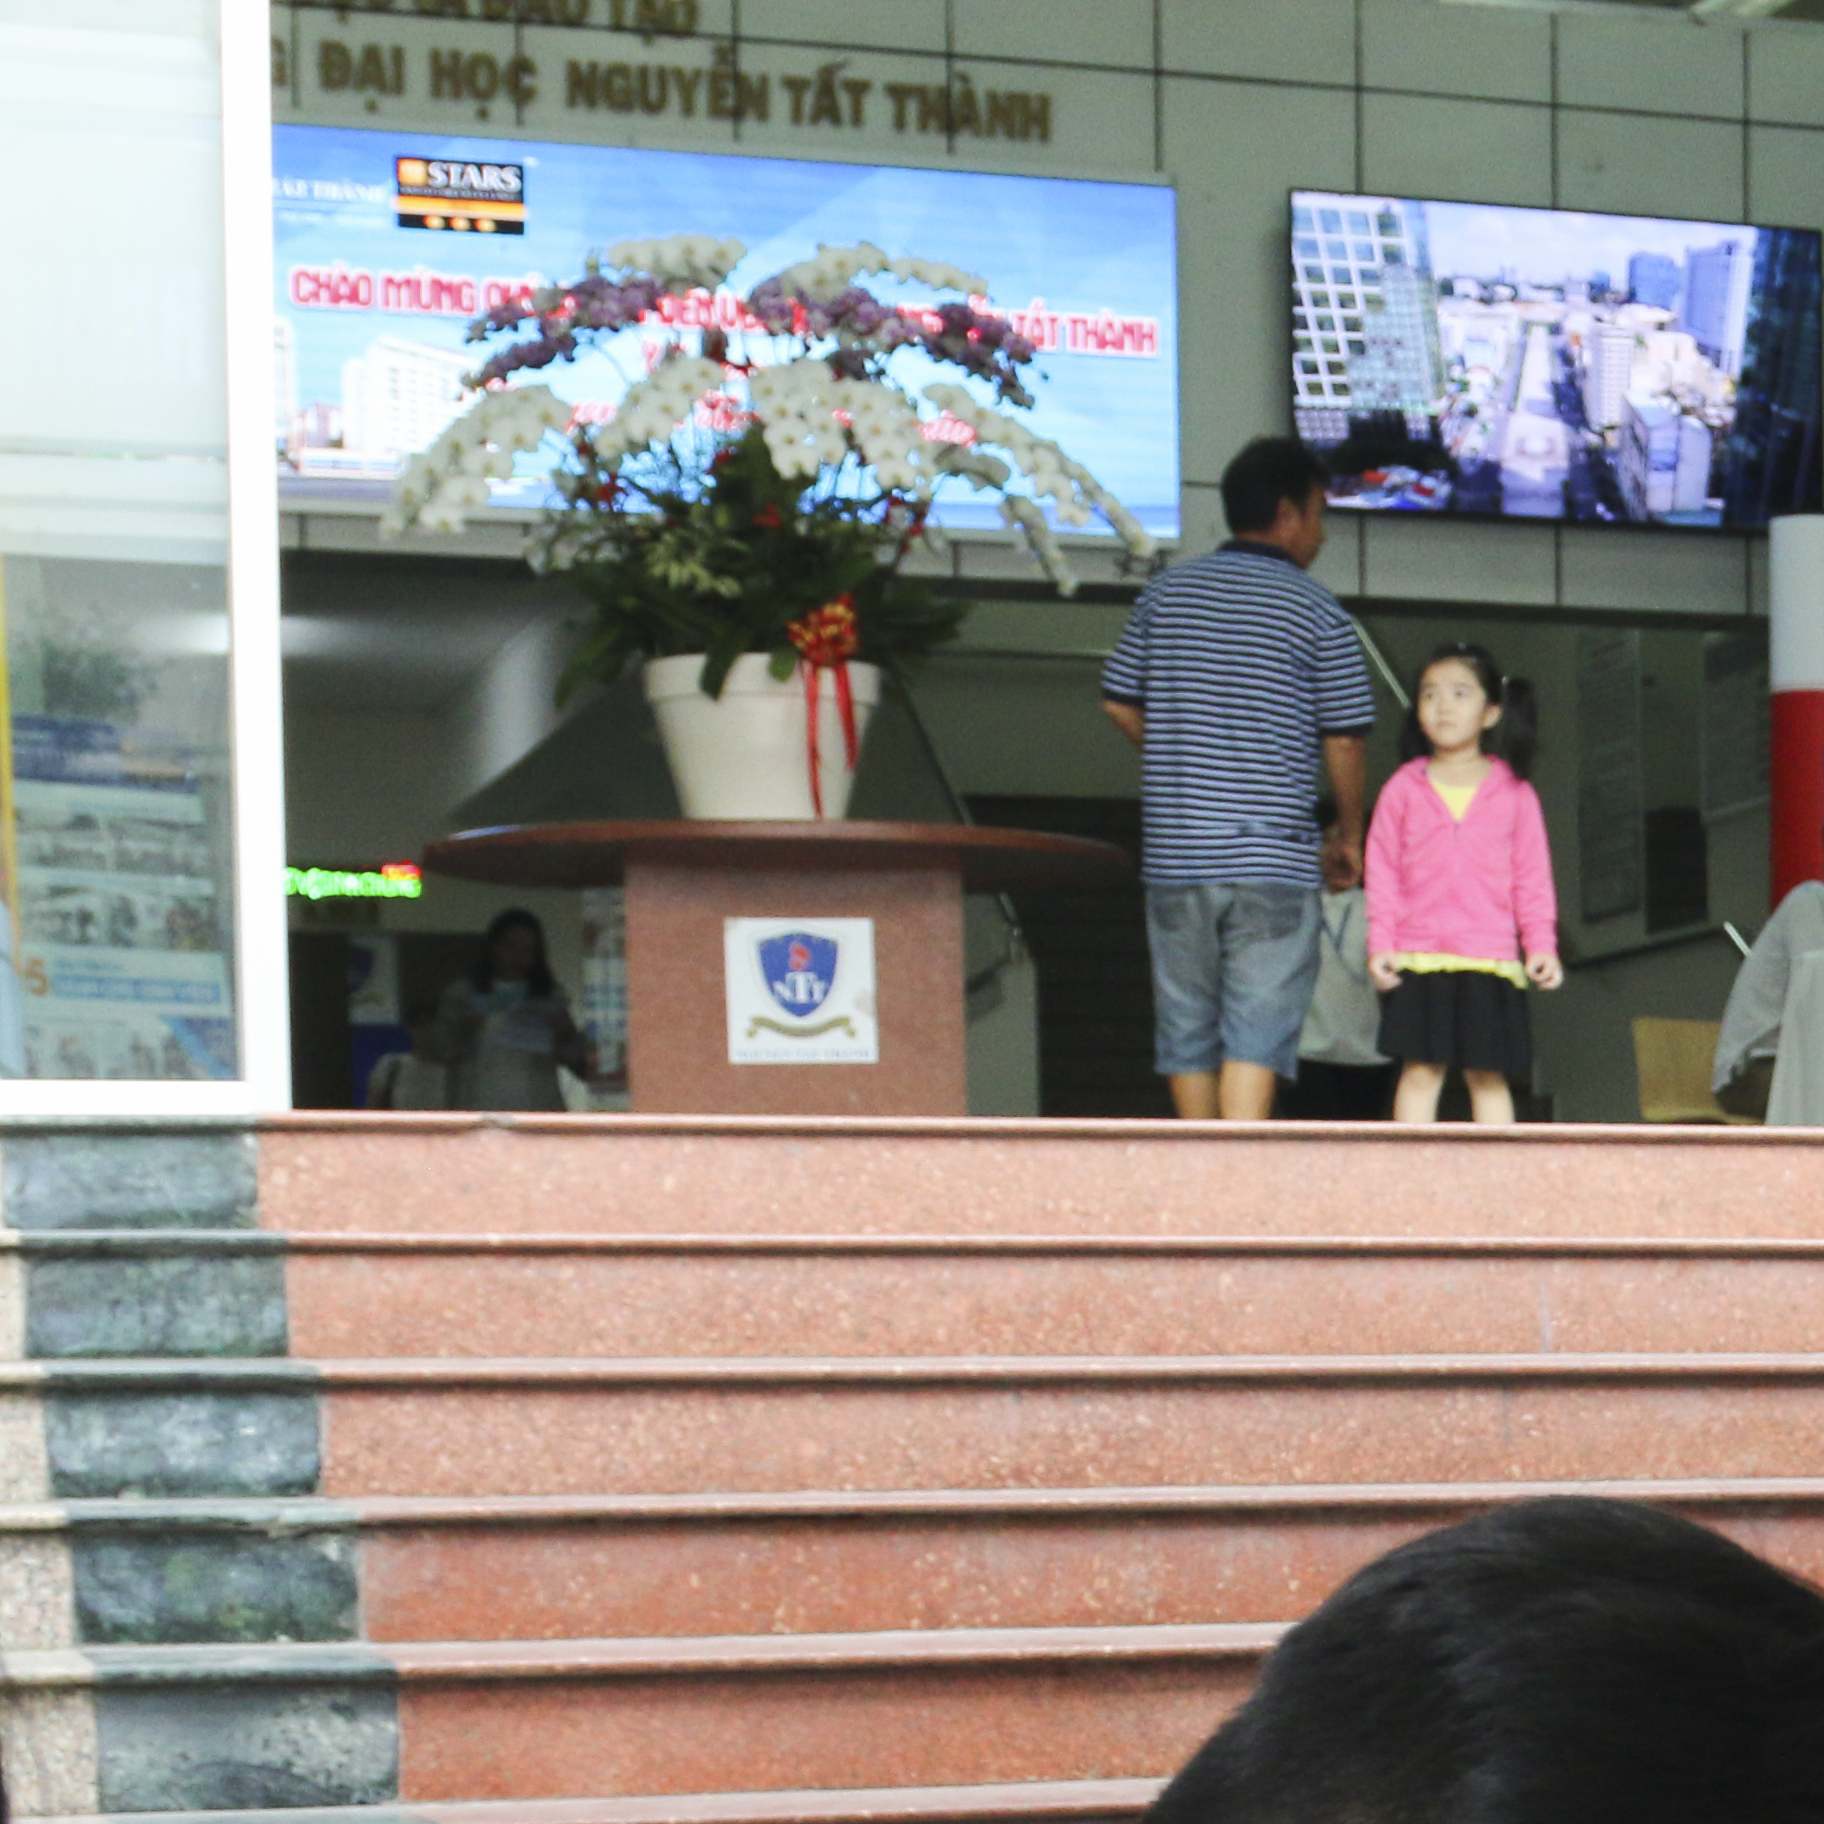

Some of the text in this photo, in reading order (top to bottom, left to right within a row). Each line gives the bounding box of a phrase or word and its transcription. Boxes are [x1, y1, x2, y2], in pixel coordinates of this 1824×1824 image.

[317, 39, 406, 116] ĐẠI
[428, 47, 539, 123] HỌC
[565, 44, 770, 125] NGUYỄN
[780, 58, 873, 129] TẤT
[883, 71, 1053, 144] THÀNH
[427, 160, 522, 193] STARS
[290, 260, 375, 309] CHÀO
[378, 265, 478, 316] MỪNG
[1064, 308, 1159, 358] THÀNH
